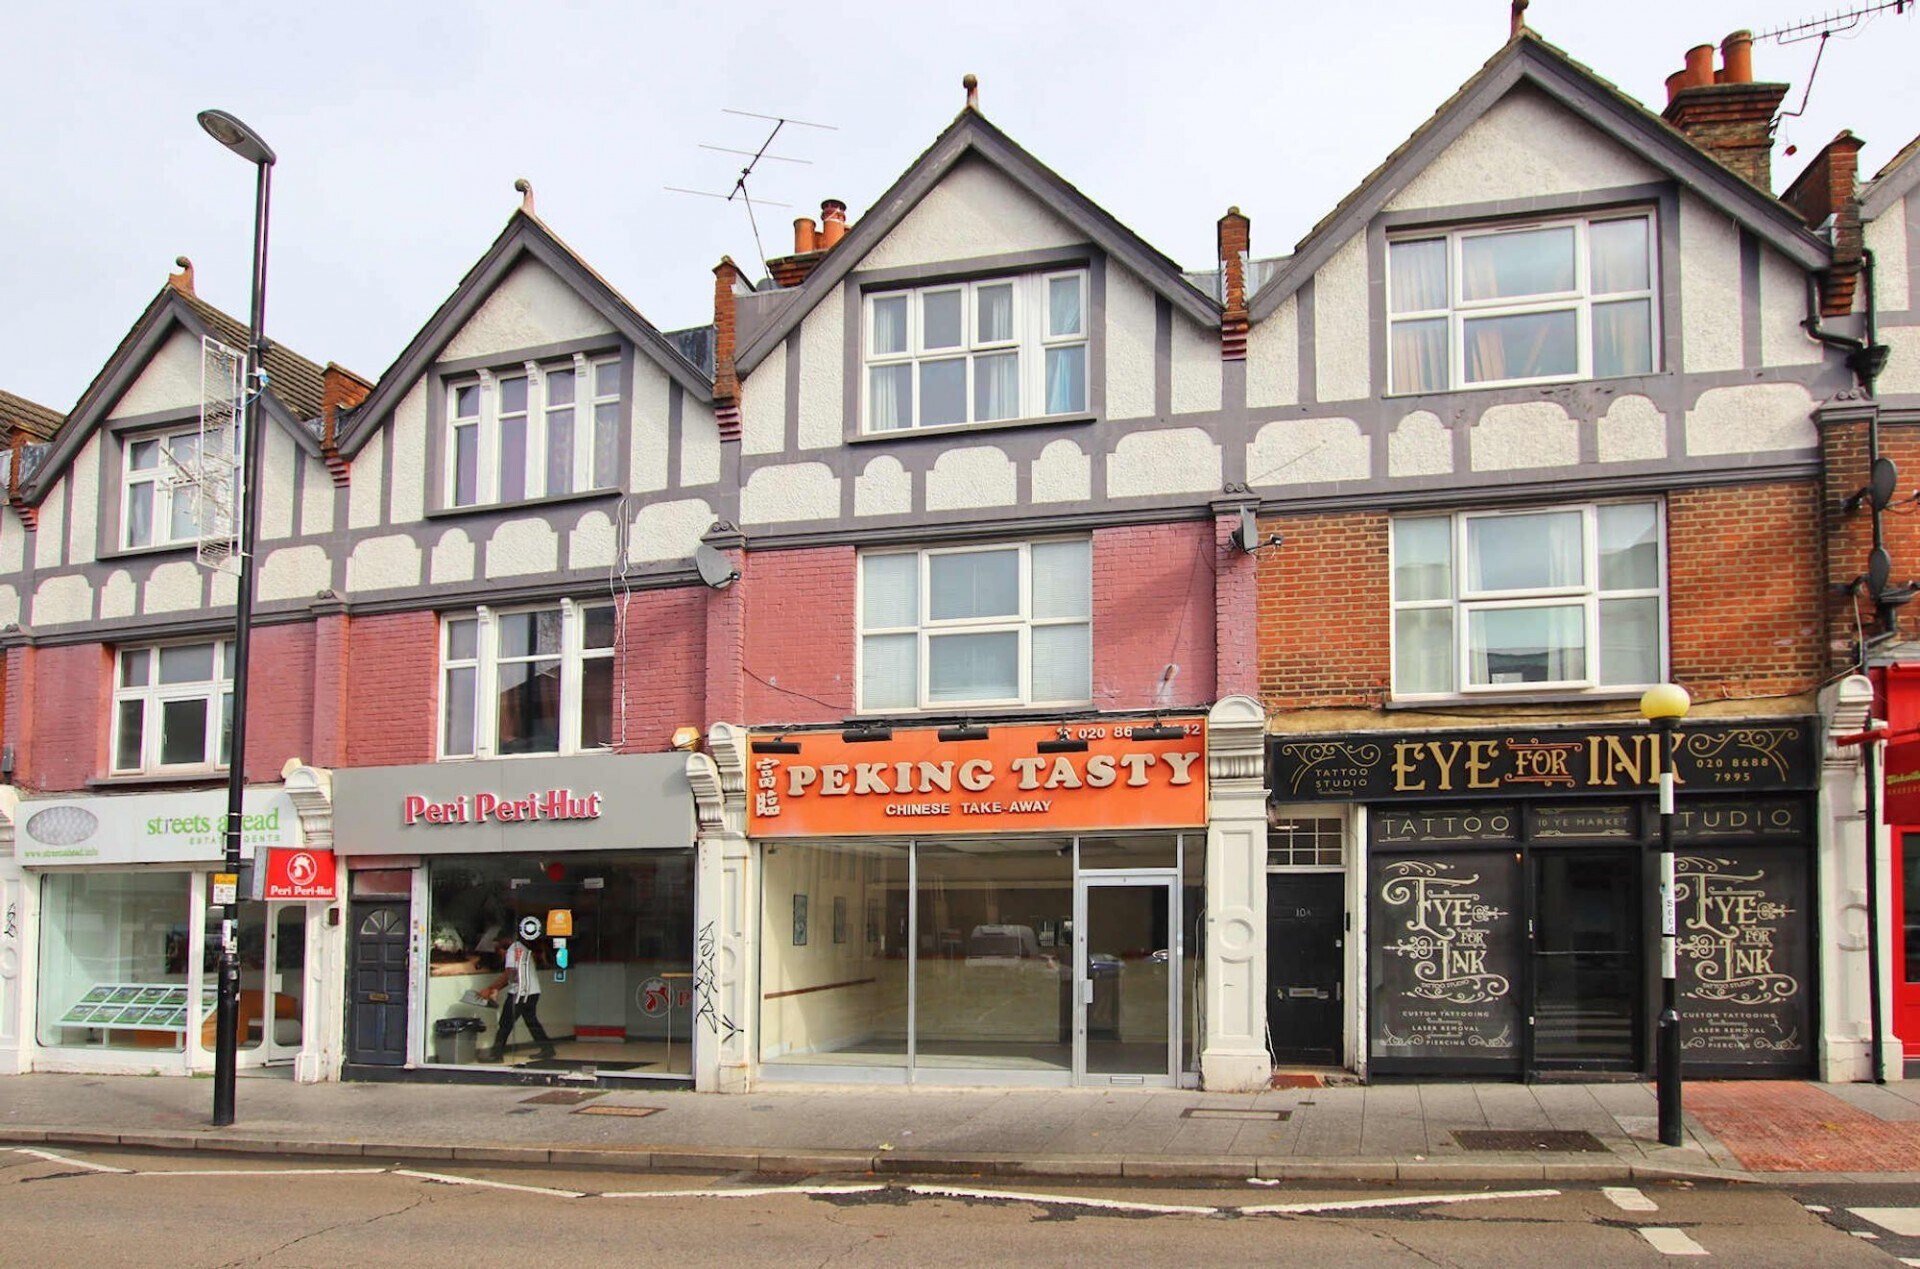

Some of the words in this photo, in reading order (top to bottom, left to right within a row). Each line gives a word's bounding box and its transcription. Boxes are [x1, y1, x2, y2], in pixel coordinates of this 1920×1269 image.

[1078, 727, 1106, 739] 020
[1391, 740, 1500, 791] EYE
[1516, 749, 1570, 776] FOR
[1586, 733, 1686, 785] INK
[1696, 758, 1723, 768] 020
[1732, 757, 1769, 768] 8688
[786, 758, 996, 797] PEKING
[1011, 752, 1200, 790] TASTY
[1315, 768, 1369, 777] TATTOO
[1714, 772, 1750, 782] 7995
[1315, 779, 1369, 788] STUDIO
[404, 795, 466, 824] Peri
[474, 789, 601, 823] Peri-Hut
[885, 802, 950, 815] CHINESE
[961, 800, 1052, 814] TAKE-AWAY
[146, 814, 211, 835] streets
[217, 807, 280, 831] aead
[1576, 817, 1628, 827] MARKET
[1678, 809, 1792, 828] TUDIO
[1383, 815, 1510, 835] TATTOO
[270, 885, 292, 896] Peri
[1461, 932, 1484, 944] FOR
[1745, 931, 1770, 943] FOR
[1440, 1010, 1490, 1018] TATTOOING
